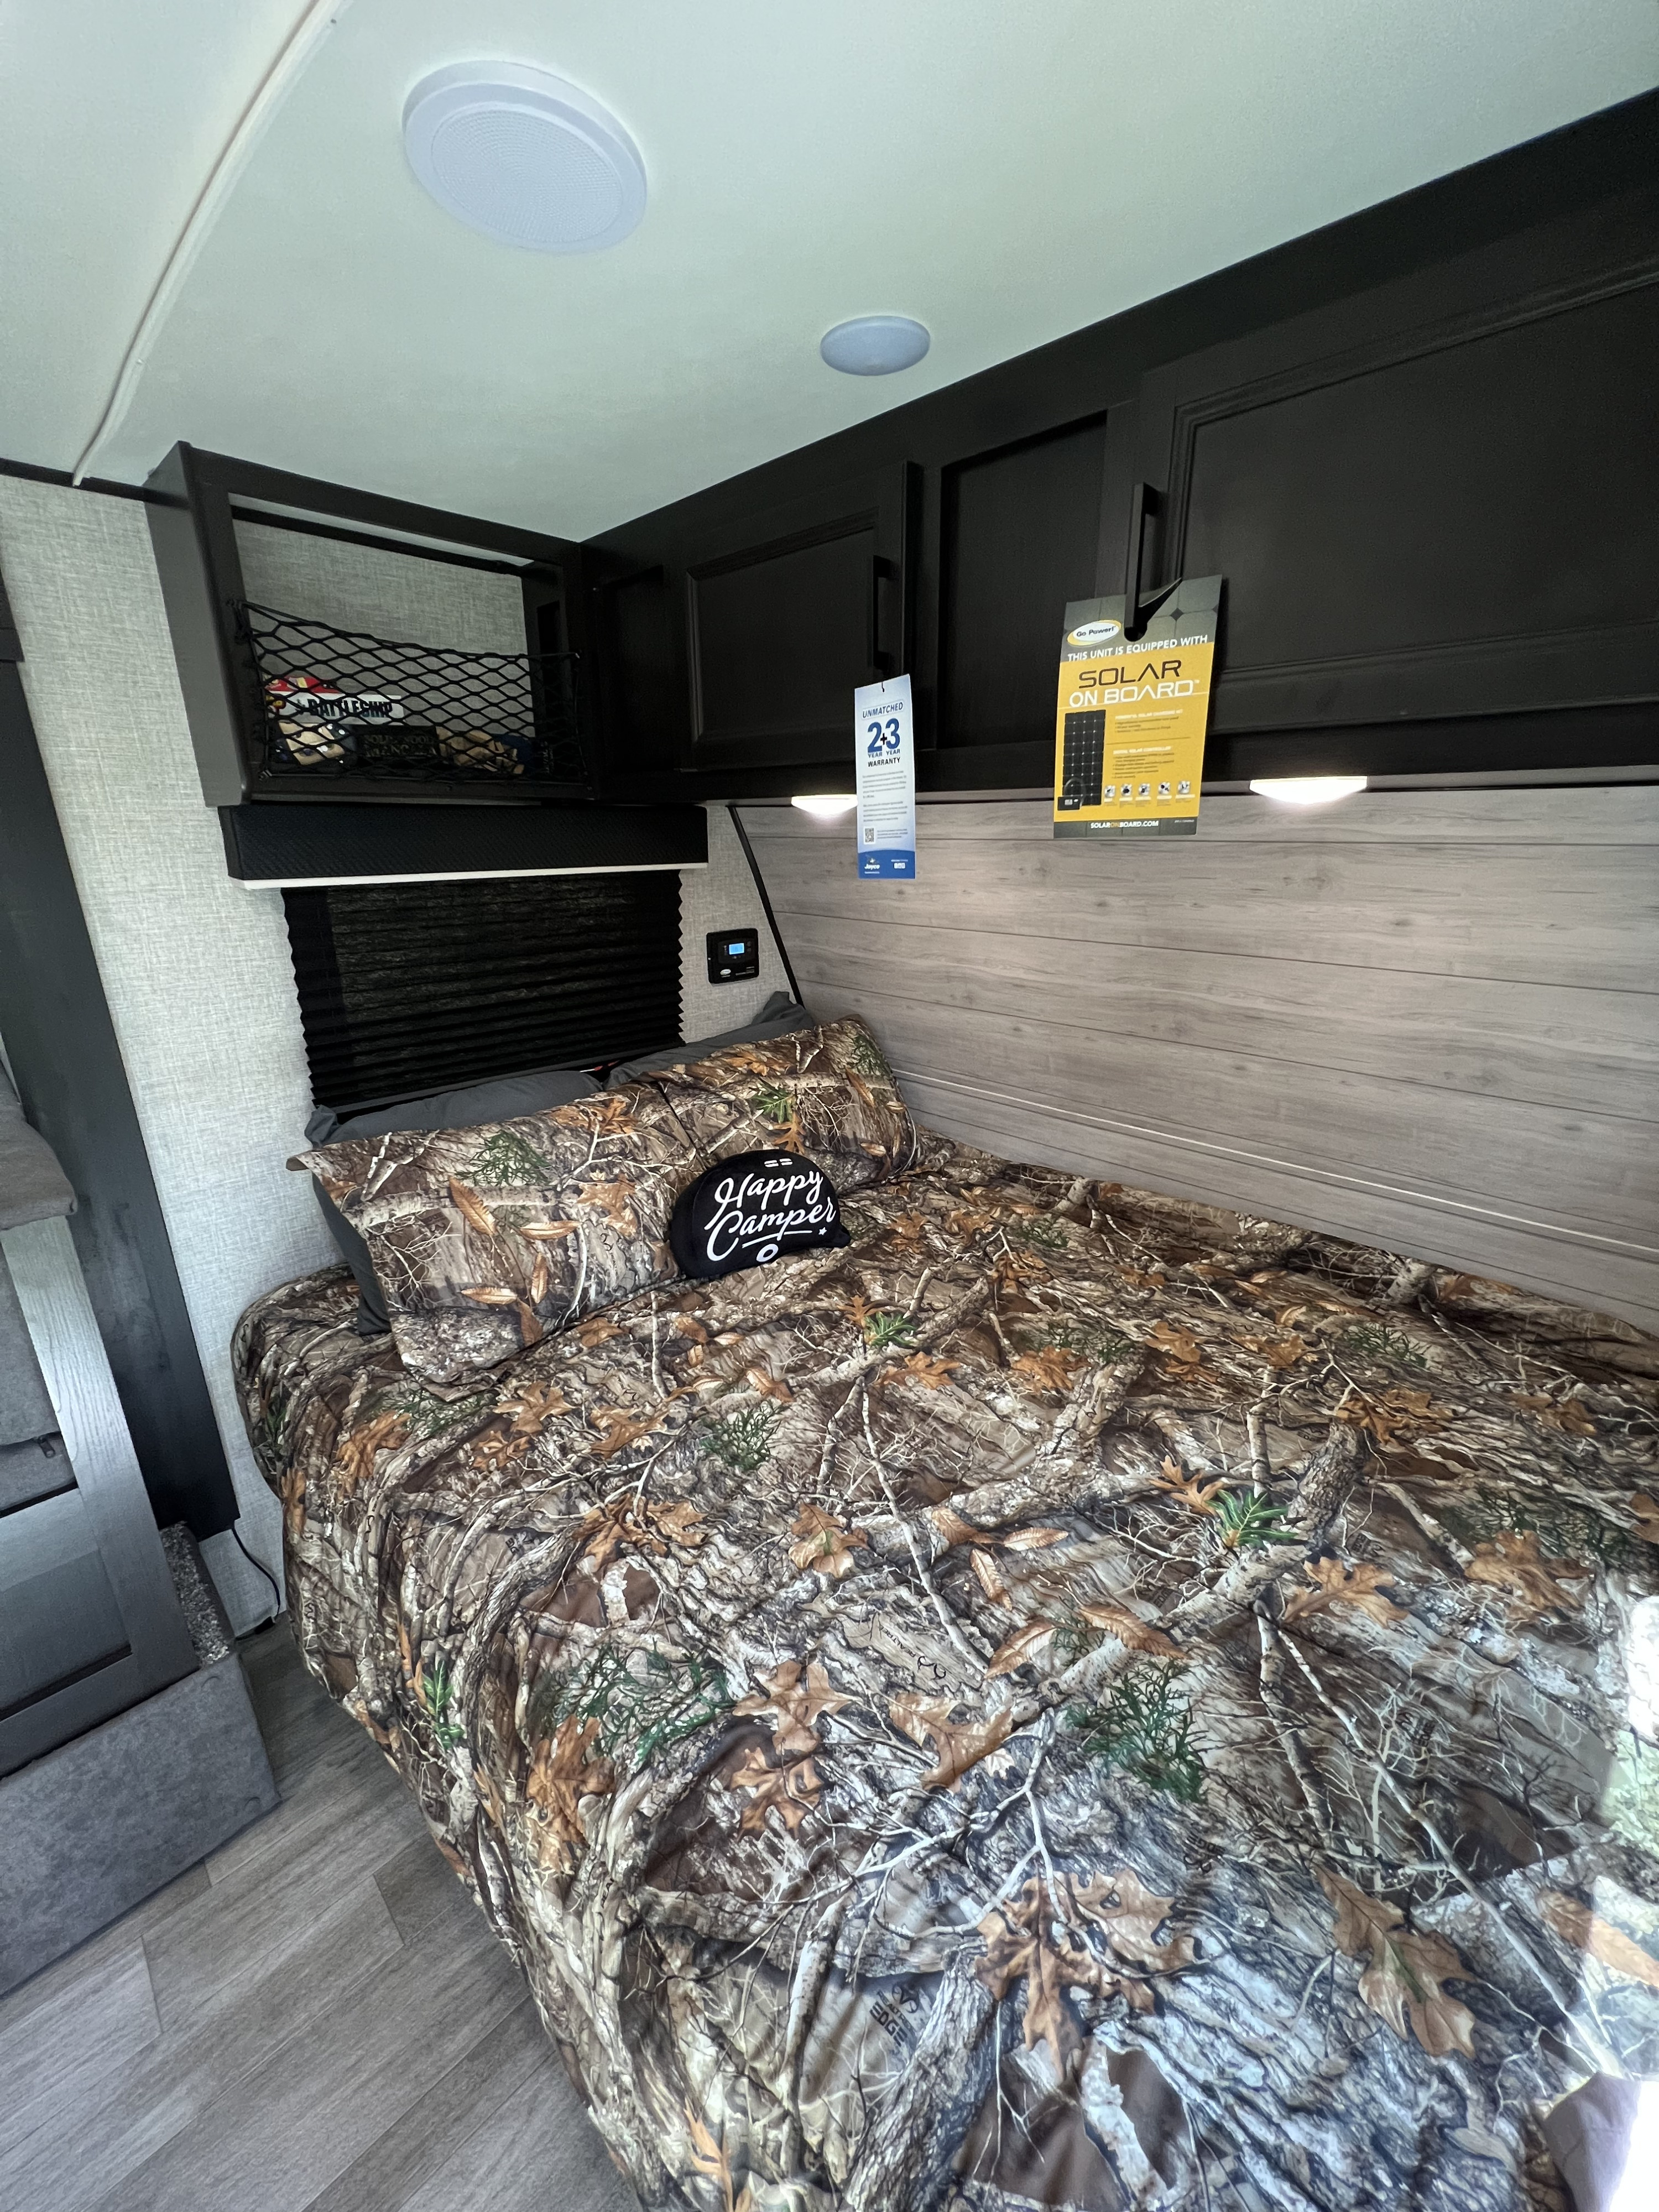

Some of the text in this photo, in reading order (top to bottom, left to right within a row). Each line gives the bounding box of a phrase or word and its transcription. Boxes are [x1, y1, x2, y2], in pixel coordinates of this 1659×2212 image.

[1067, 634, 1208, 662] THIS UNIT IS EQUIPPED WITH
[1078, 659, 1182, 689] SOLAR
[862, 702, 904, 718] UNMATCHED
[1068, 689, 1098, 708] ON
[363, 744, 437, 758] MANCA
[868, 756, 901, 768] WARRANTY
[1090, 821, 1159, 829] SOLARONBOARD.COM
[704, 1170, 824, 1230] Happy
[706, 1196, 837, 1261] Camper
[868, 2000, 908, 2047] EDGE
